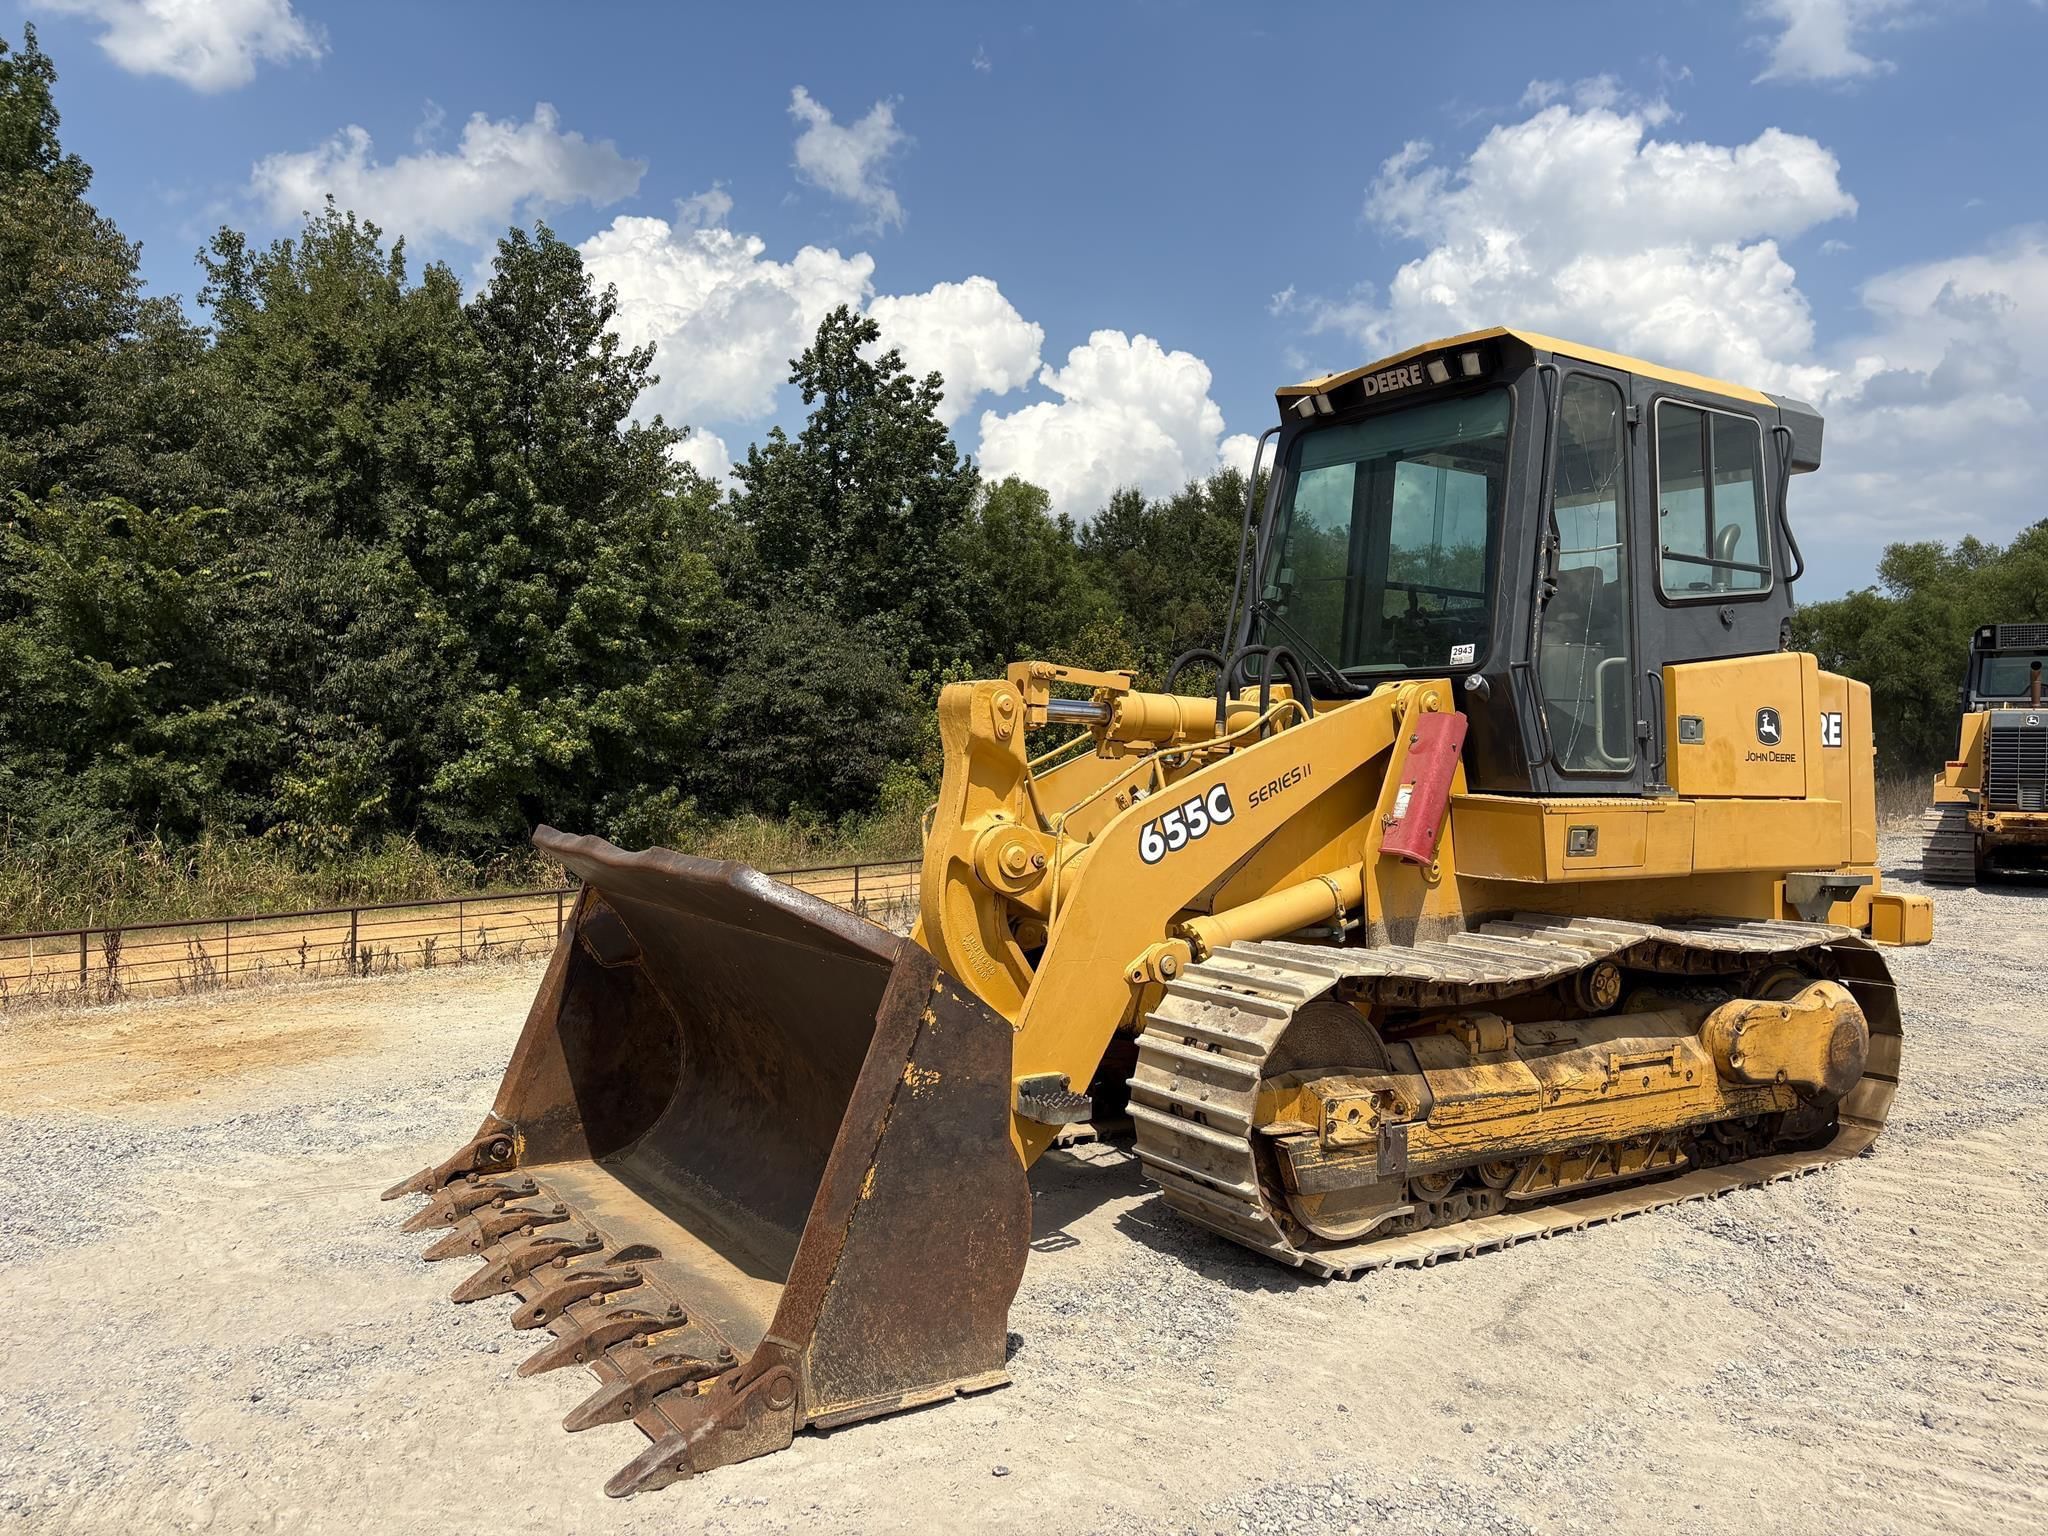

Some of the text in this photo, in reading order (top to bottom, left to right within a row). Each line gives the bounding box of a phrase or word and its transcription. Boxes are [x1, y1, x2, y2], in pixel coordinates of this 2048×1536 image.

[1363, 364, 1422, 397] DEERE
[1452, 646, 1473, 656] 2943
[1745, 750, 1796, 763] JOHN DEERE
[1248, 766, 1301, 809] SERIES
[1138, 782, 1235, 864] 655C
